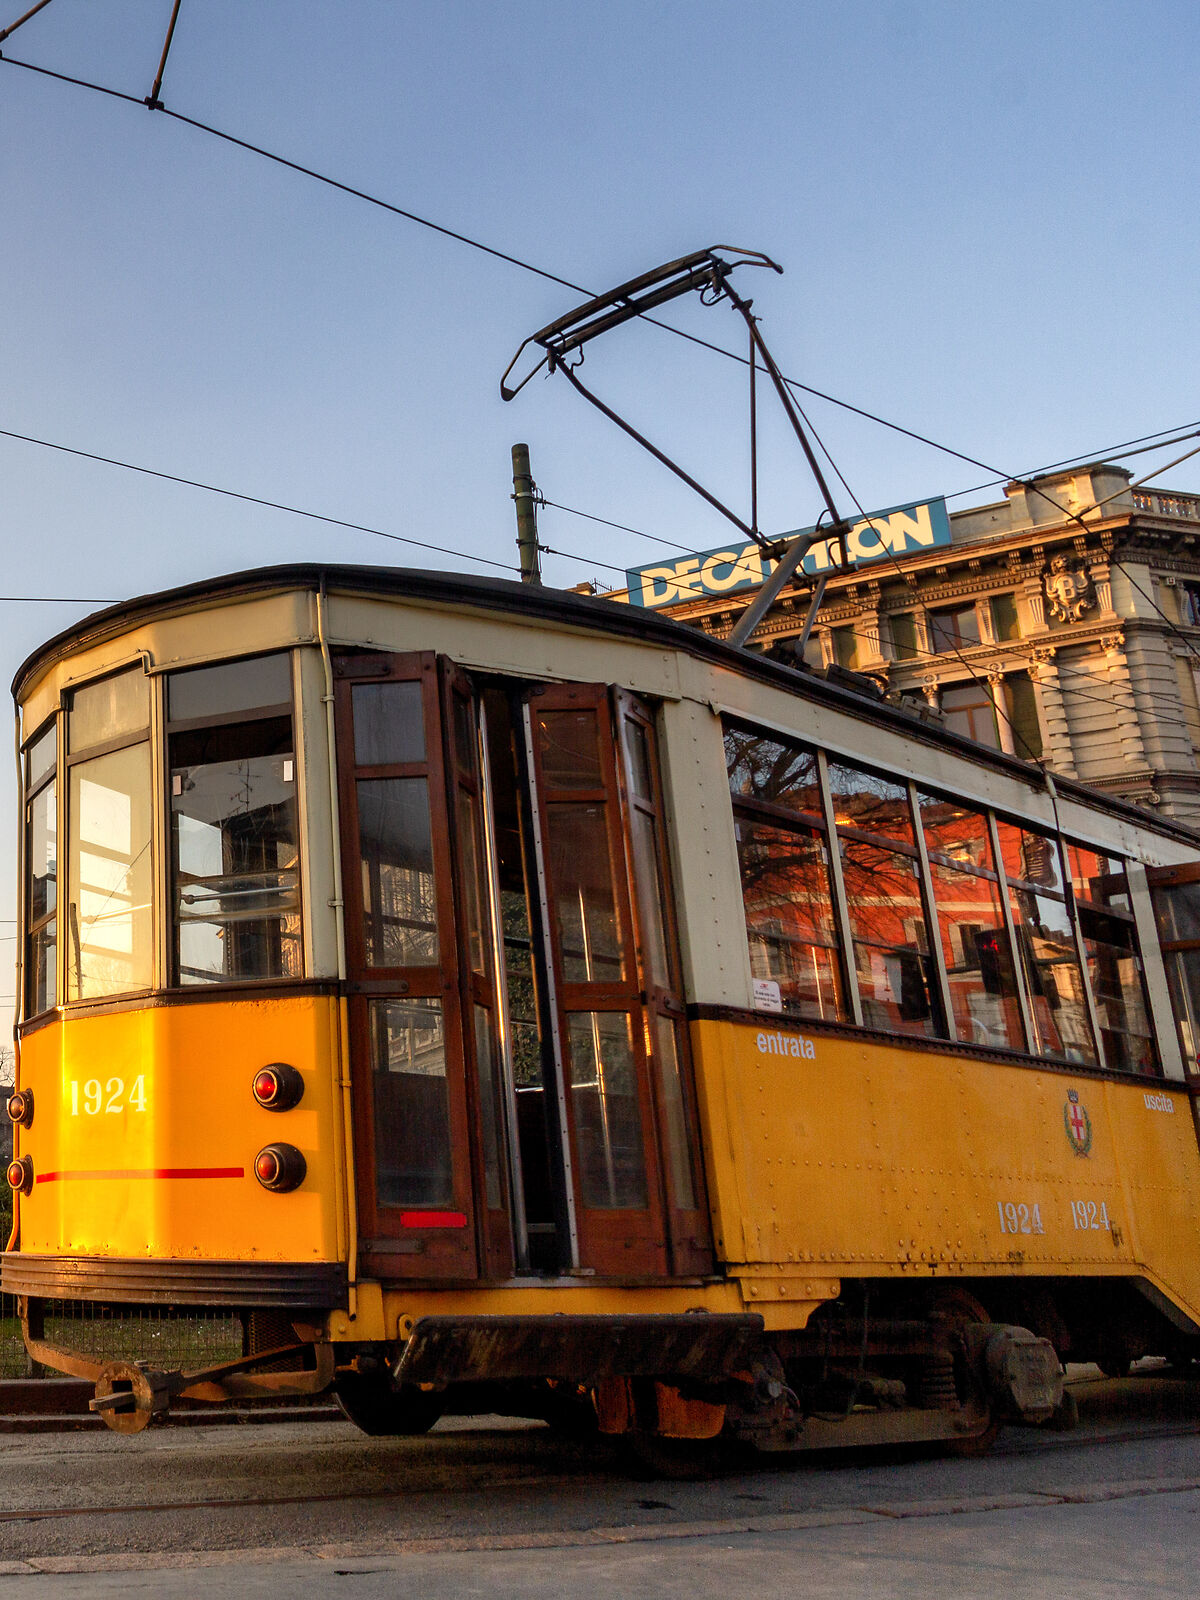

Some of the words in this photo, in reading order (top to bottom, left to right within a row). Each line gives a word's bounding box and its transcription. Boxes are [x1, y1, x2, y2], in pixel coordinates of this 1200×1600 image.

[756, 1031, 816, 1060] entrata
[70, 1074, 147, 1116] 1924
[1143, 1093, 1174, 1113] uscita
[997, 1201, 1045, 1234] 1924
[1070, 1200, 1110, 1231] 1924
